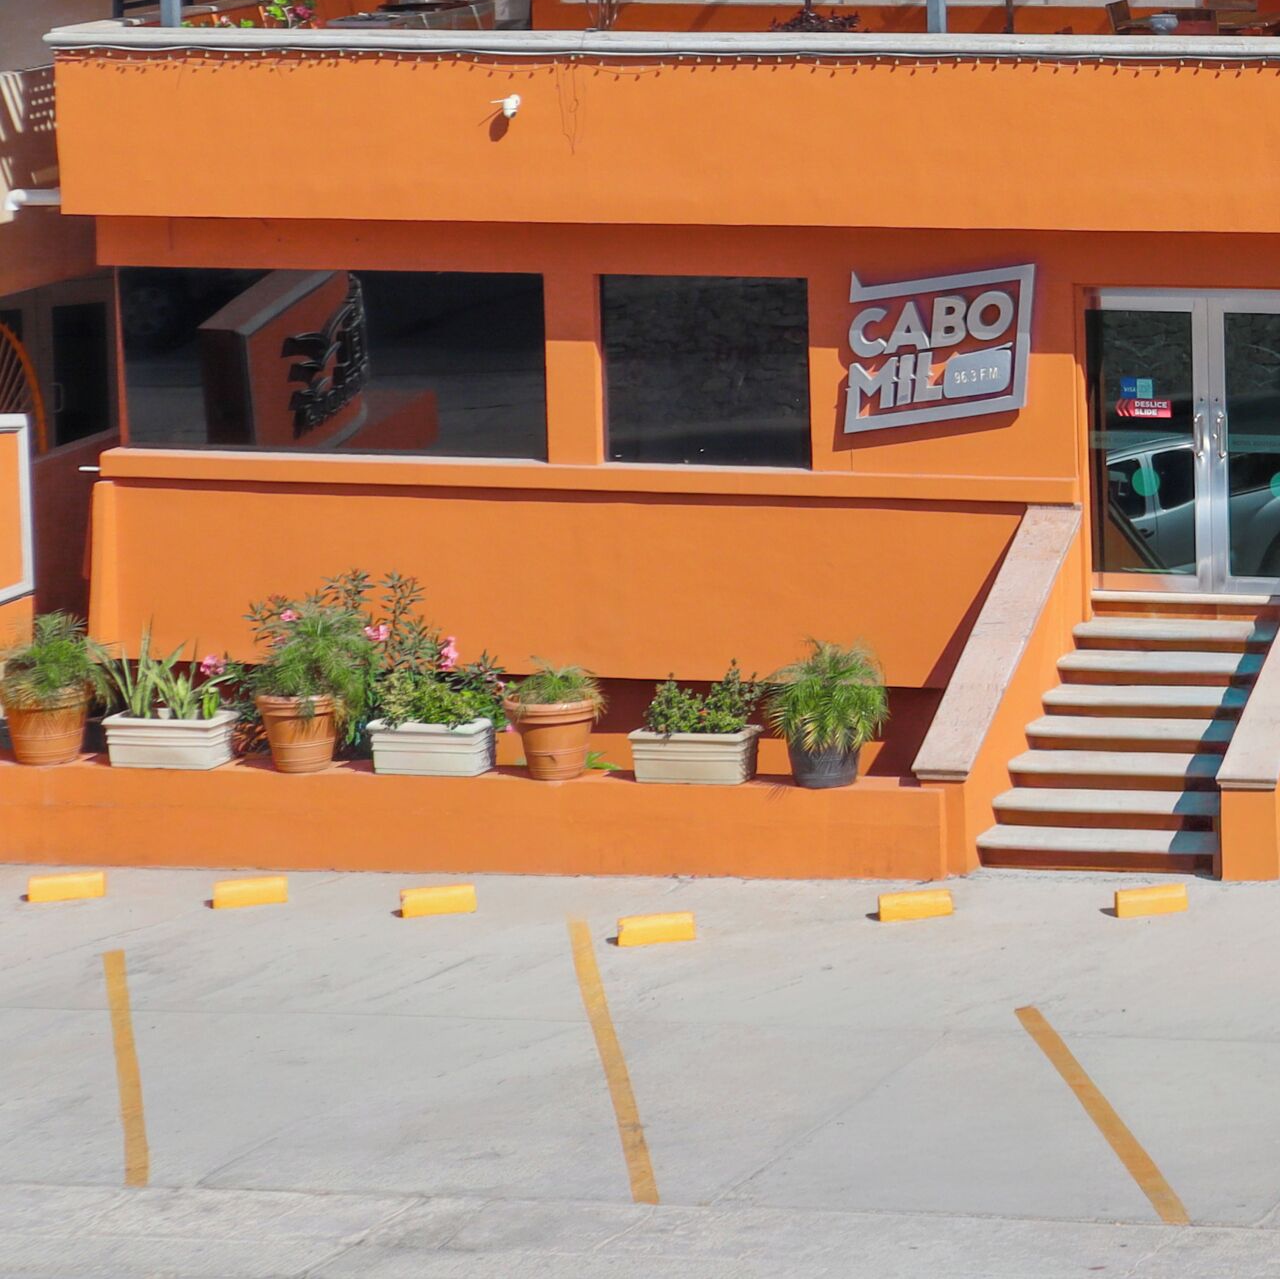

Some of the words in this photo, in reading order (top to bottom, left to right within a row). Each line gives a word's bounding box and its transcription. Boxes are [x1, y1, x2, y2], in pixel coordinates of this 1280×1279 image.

[849, 290, 1014, 358] CABO
[953, 369, 977, 384] 96.3
[849, 352, 943, 418] MIL
[1134, 400, 1168, 409] DESLICE
[1134, 408, 1158, 416] SLIDE
